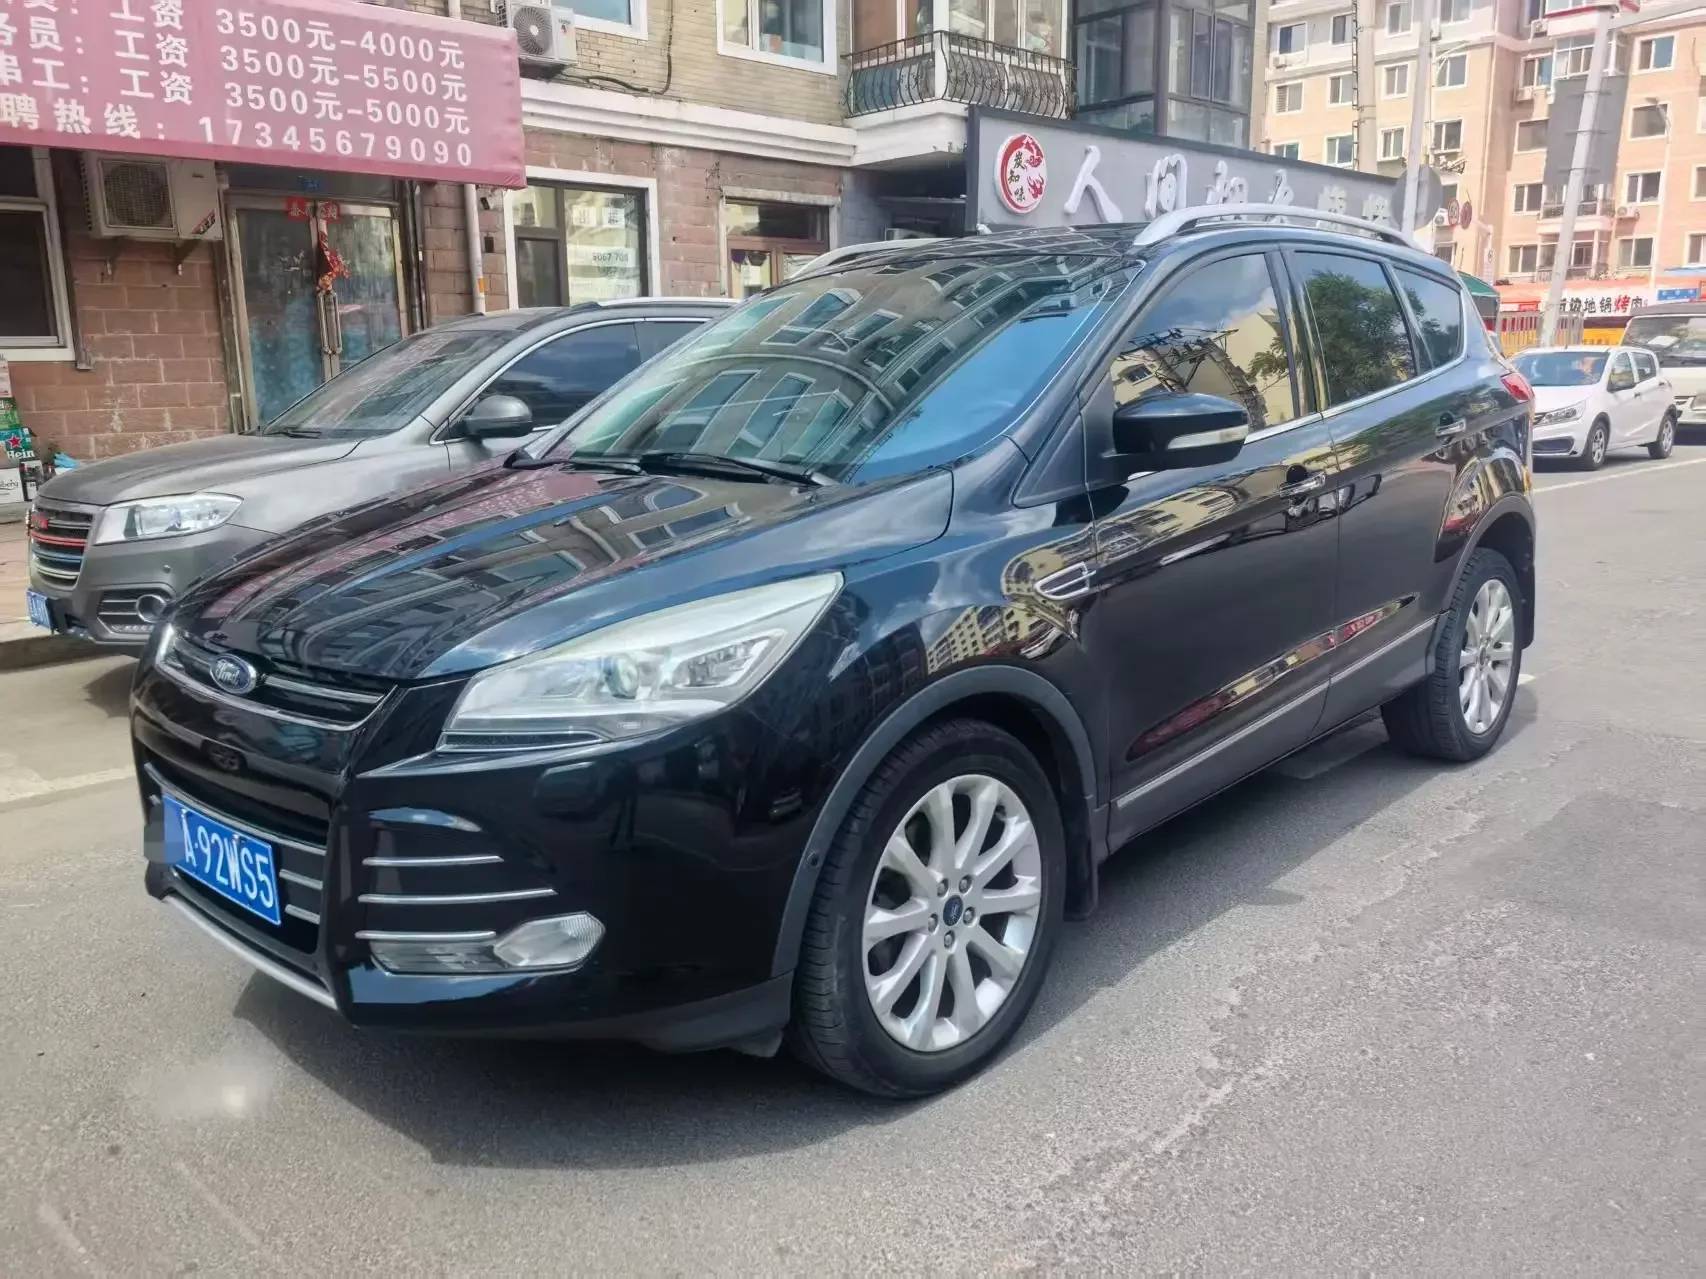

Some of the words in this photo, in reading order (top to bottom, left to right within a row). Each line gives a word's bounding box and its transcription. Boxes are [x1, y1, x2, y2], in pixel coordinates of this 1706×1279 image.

[114, 30, 189, 68] 工资
[220, 45, 468, 103] 3500元-5500元
[216, 8, 465, 69] 3500元-4000元
[119, 68, 193, 105] 工资
[225, 82, 470, 136] 3500元-5000元
[199, 116, 472, 168] 17345679090
[216, 661, 240, 684] Ford
